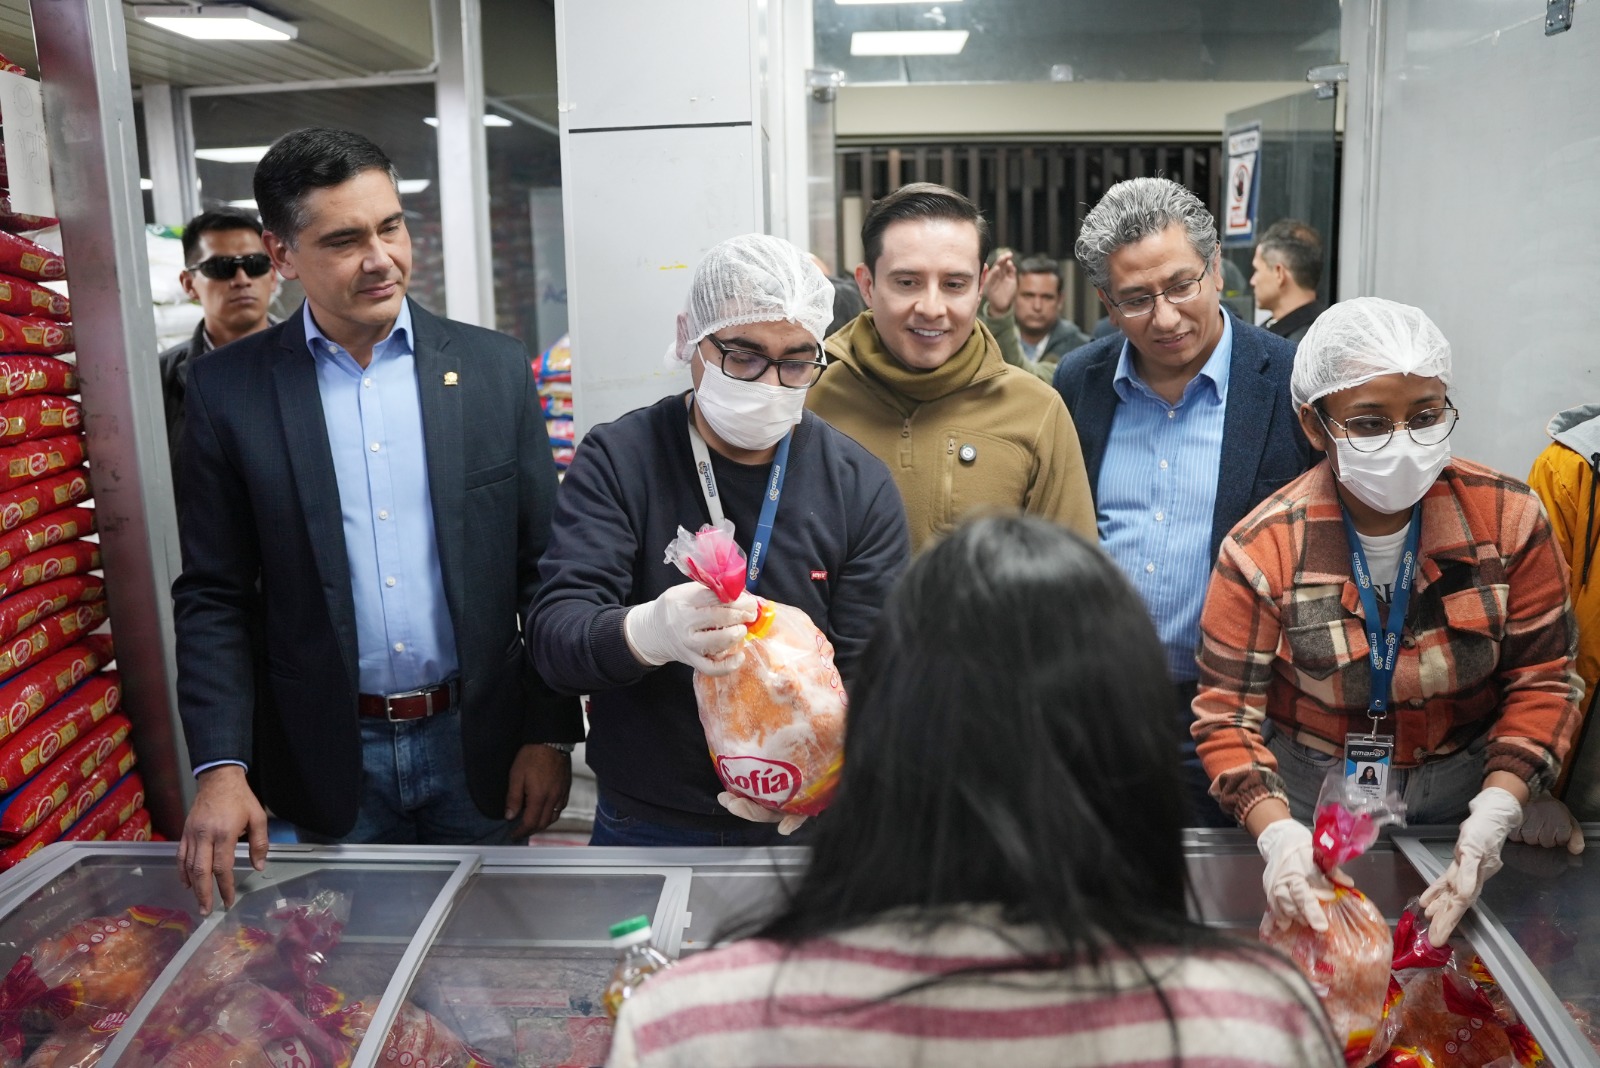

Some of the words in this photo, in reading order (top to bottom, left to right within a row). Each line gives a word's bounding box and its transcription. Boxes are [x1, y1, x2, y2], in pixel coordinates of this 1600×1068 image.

[702, 462, 714, 498] emapa
[770, 464, 780, 497] emapa
[752, 541, 762, 577] emapa
[1353, 552, 1368, 588] emapa
[1401, 554, 1412, 589] emapa
[1371, 633, 1381, 669] emapa
[1385, 636, 1396, 671] emapa
[1351, 749, 1381, 758] emapa
[721, 762, 789, 796] Sofía
